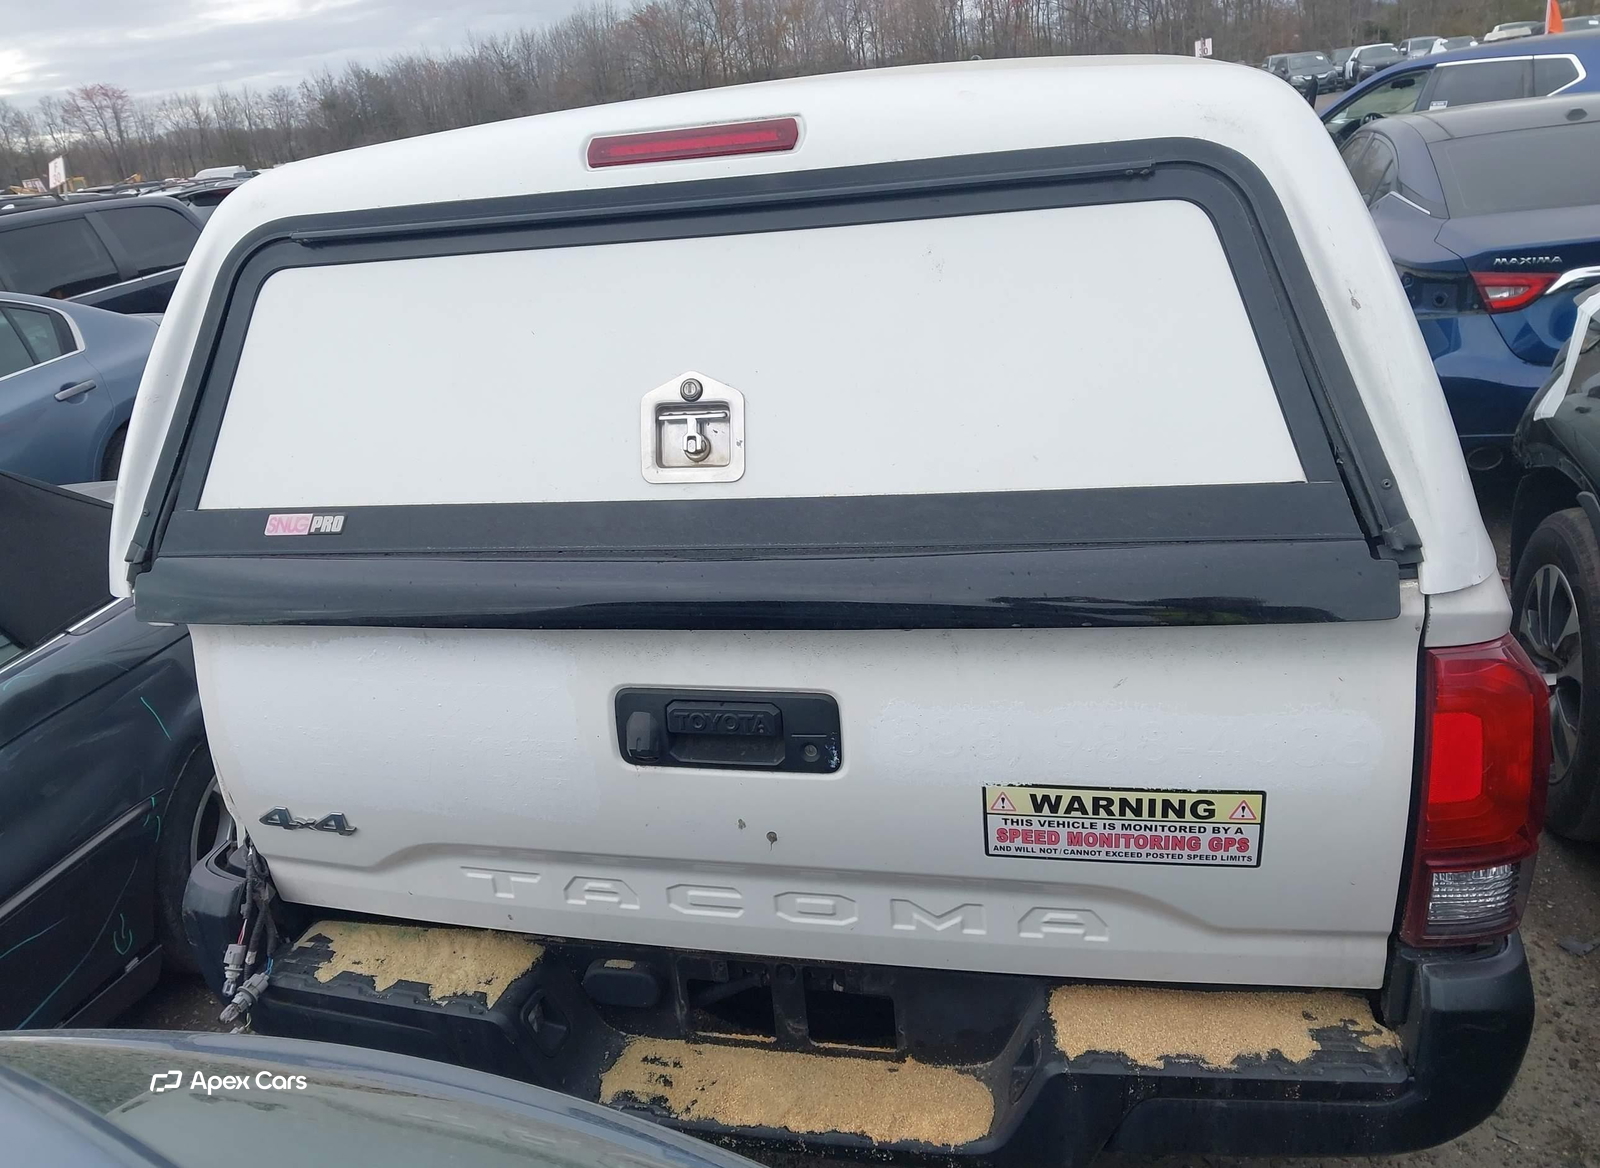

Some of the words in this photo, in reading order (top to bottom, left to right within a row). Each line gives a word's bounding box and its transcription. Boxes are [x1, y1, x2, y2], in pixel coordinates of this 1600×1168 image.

[1493, 255, 1563, 266] MAXIMA
[266, 516, 310, 533] SNUG
[310, 515, 345, 533] PRO
[673, 711, 773, 734] TOYOTA
[1029, 792, 1217, 820] WARNING
[1001, 817, 1034, 828] THIS
[1037, 819, 1098, 830] VEHICLE
[1102, 822, 1116, 831] IS
[1120, 823, 1207, 834] MONITORED
[1211, 826, 1232, 835] BY
[1234, 826, 1245, 835] A
[996, 828, 1061, 846] SPEED
[1066, 831, 1202, 852] MONITORING
[1207, 836, 1250, 853] GPS
[1105, 850, 1143, 858] EXCEED
[460, 865, 1110, 943] TACOMA
